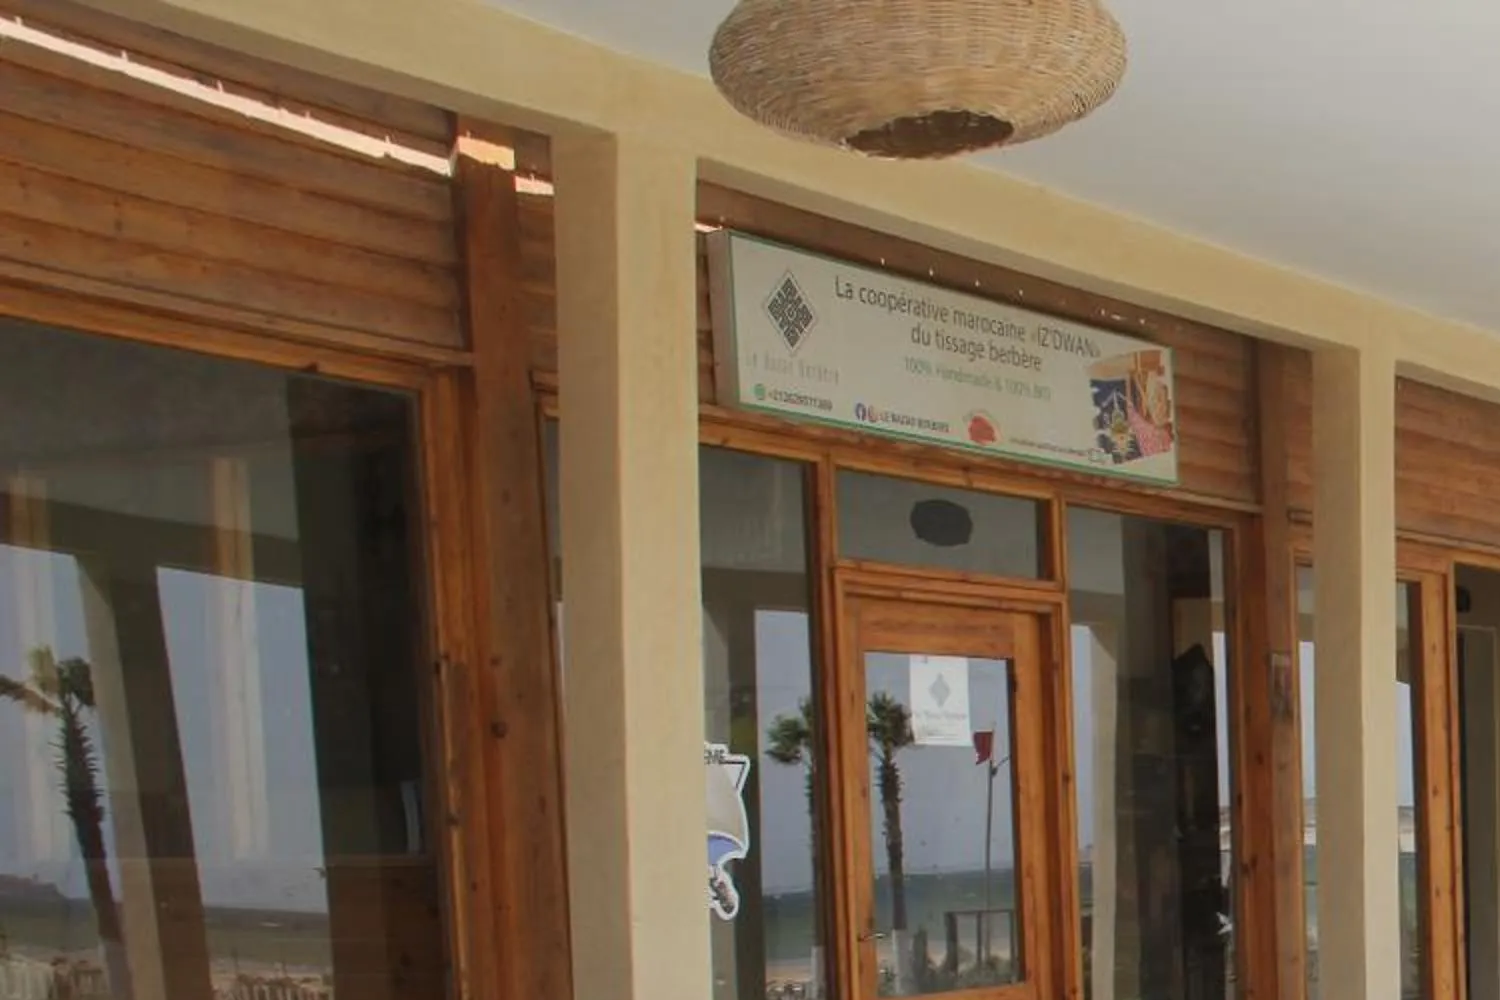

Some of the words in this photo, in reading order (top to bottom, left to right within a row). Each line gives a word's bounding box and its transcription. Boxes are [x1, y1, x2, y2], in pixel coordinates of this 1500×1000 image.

[835, 275, 854, 300] La
[859, 286, 949, 323] coopérative
[953, 309, 1026, 342] marocaine
[911, 321, 931, 347] du
[935, 327, 986, 363] tissage
[989, 339, 1043, 372] berbère
